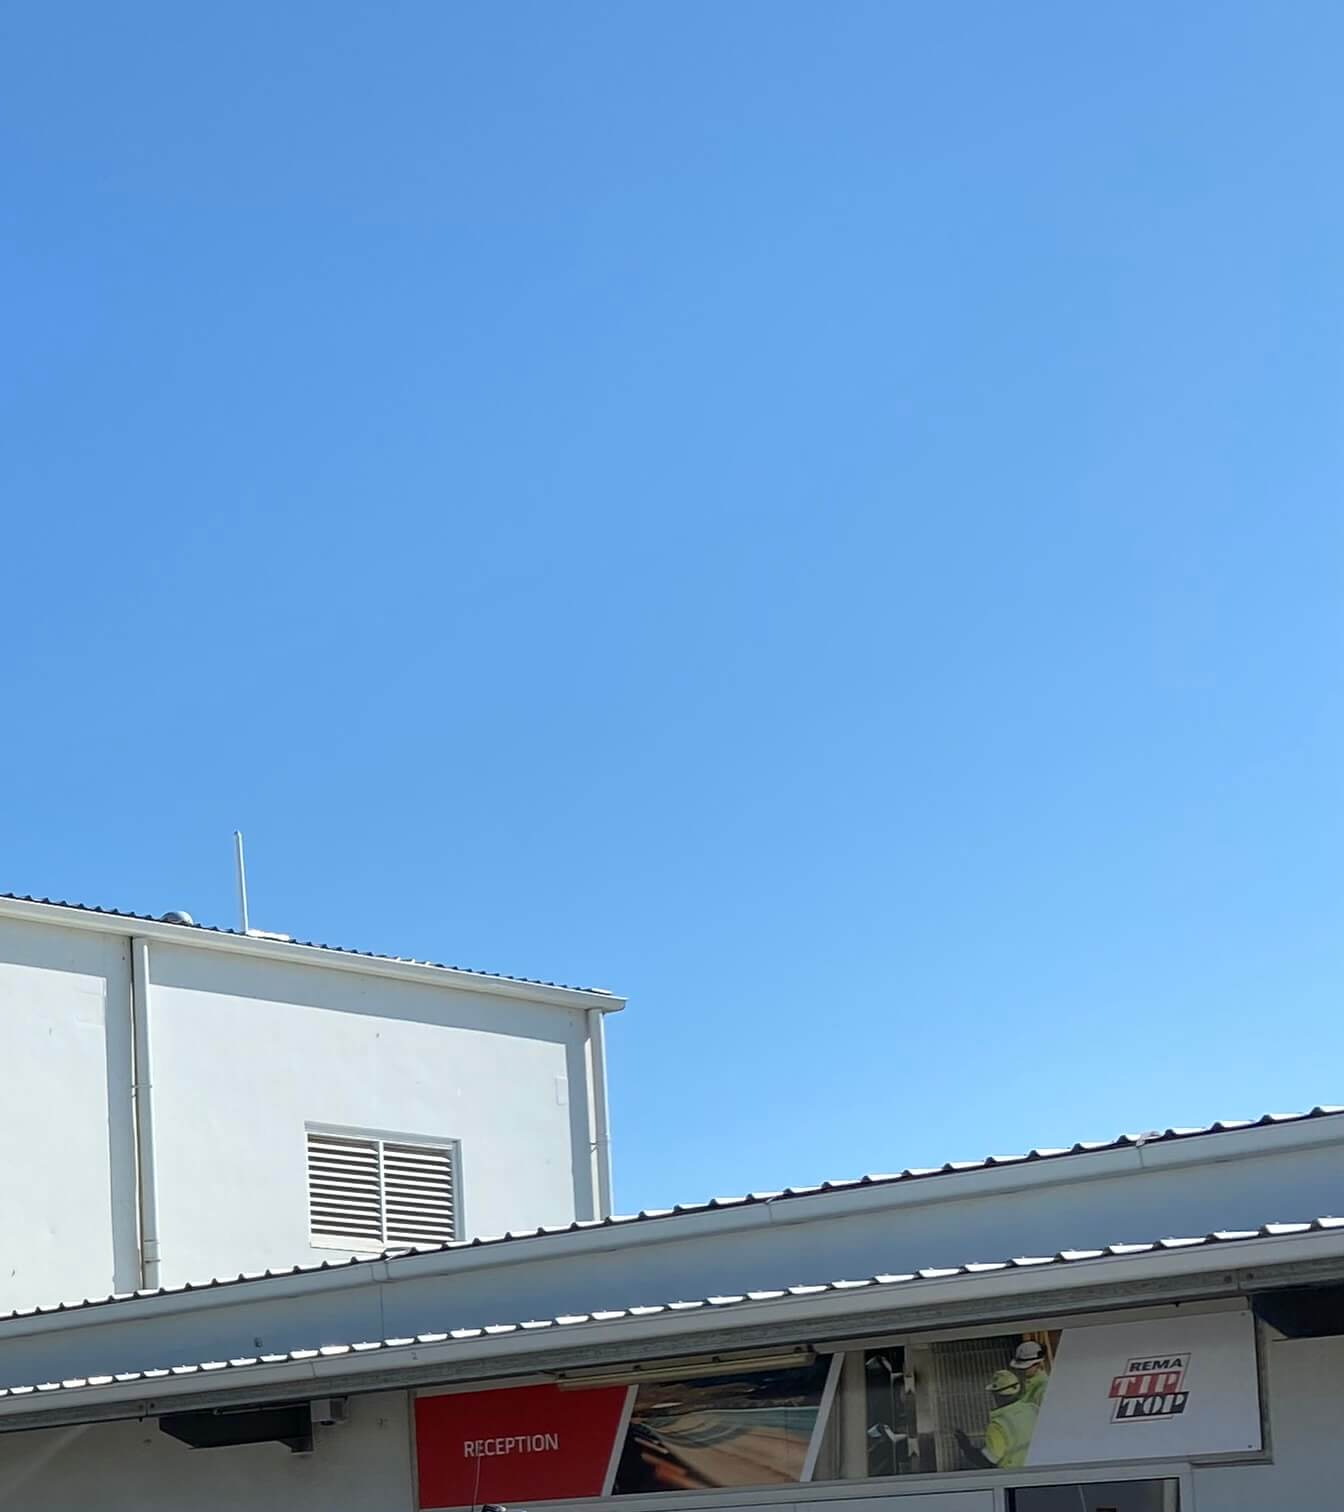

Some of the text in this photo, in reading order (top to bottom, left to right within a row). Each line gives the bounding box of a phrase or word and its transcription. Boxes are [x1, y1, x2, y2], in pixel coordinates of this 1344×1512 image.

[1129, 1358, 1183, 1372] REMA
[1114, 1373, 1178, 1396] TIP
[1122, 1394, 1185, 1417] TOP
[463, 1433, 560, 1458] RECEPTION
